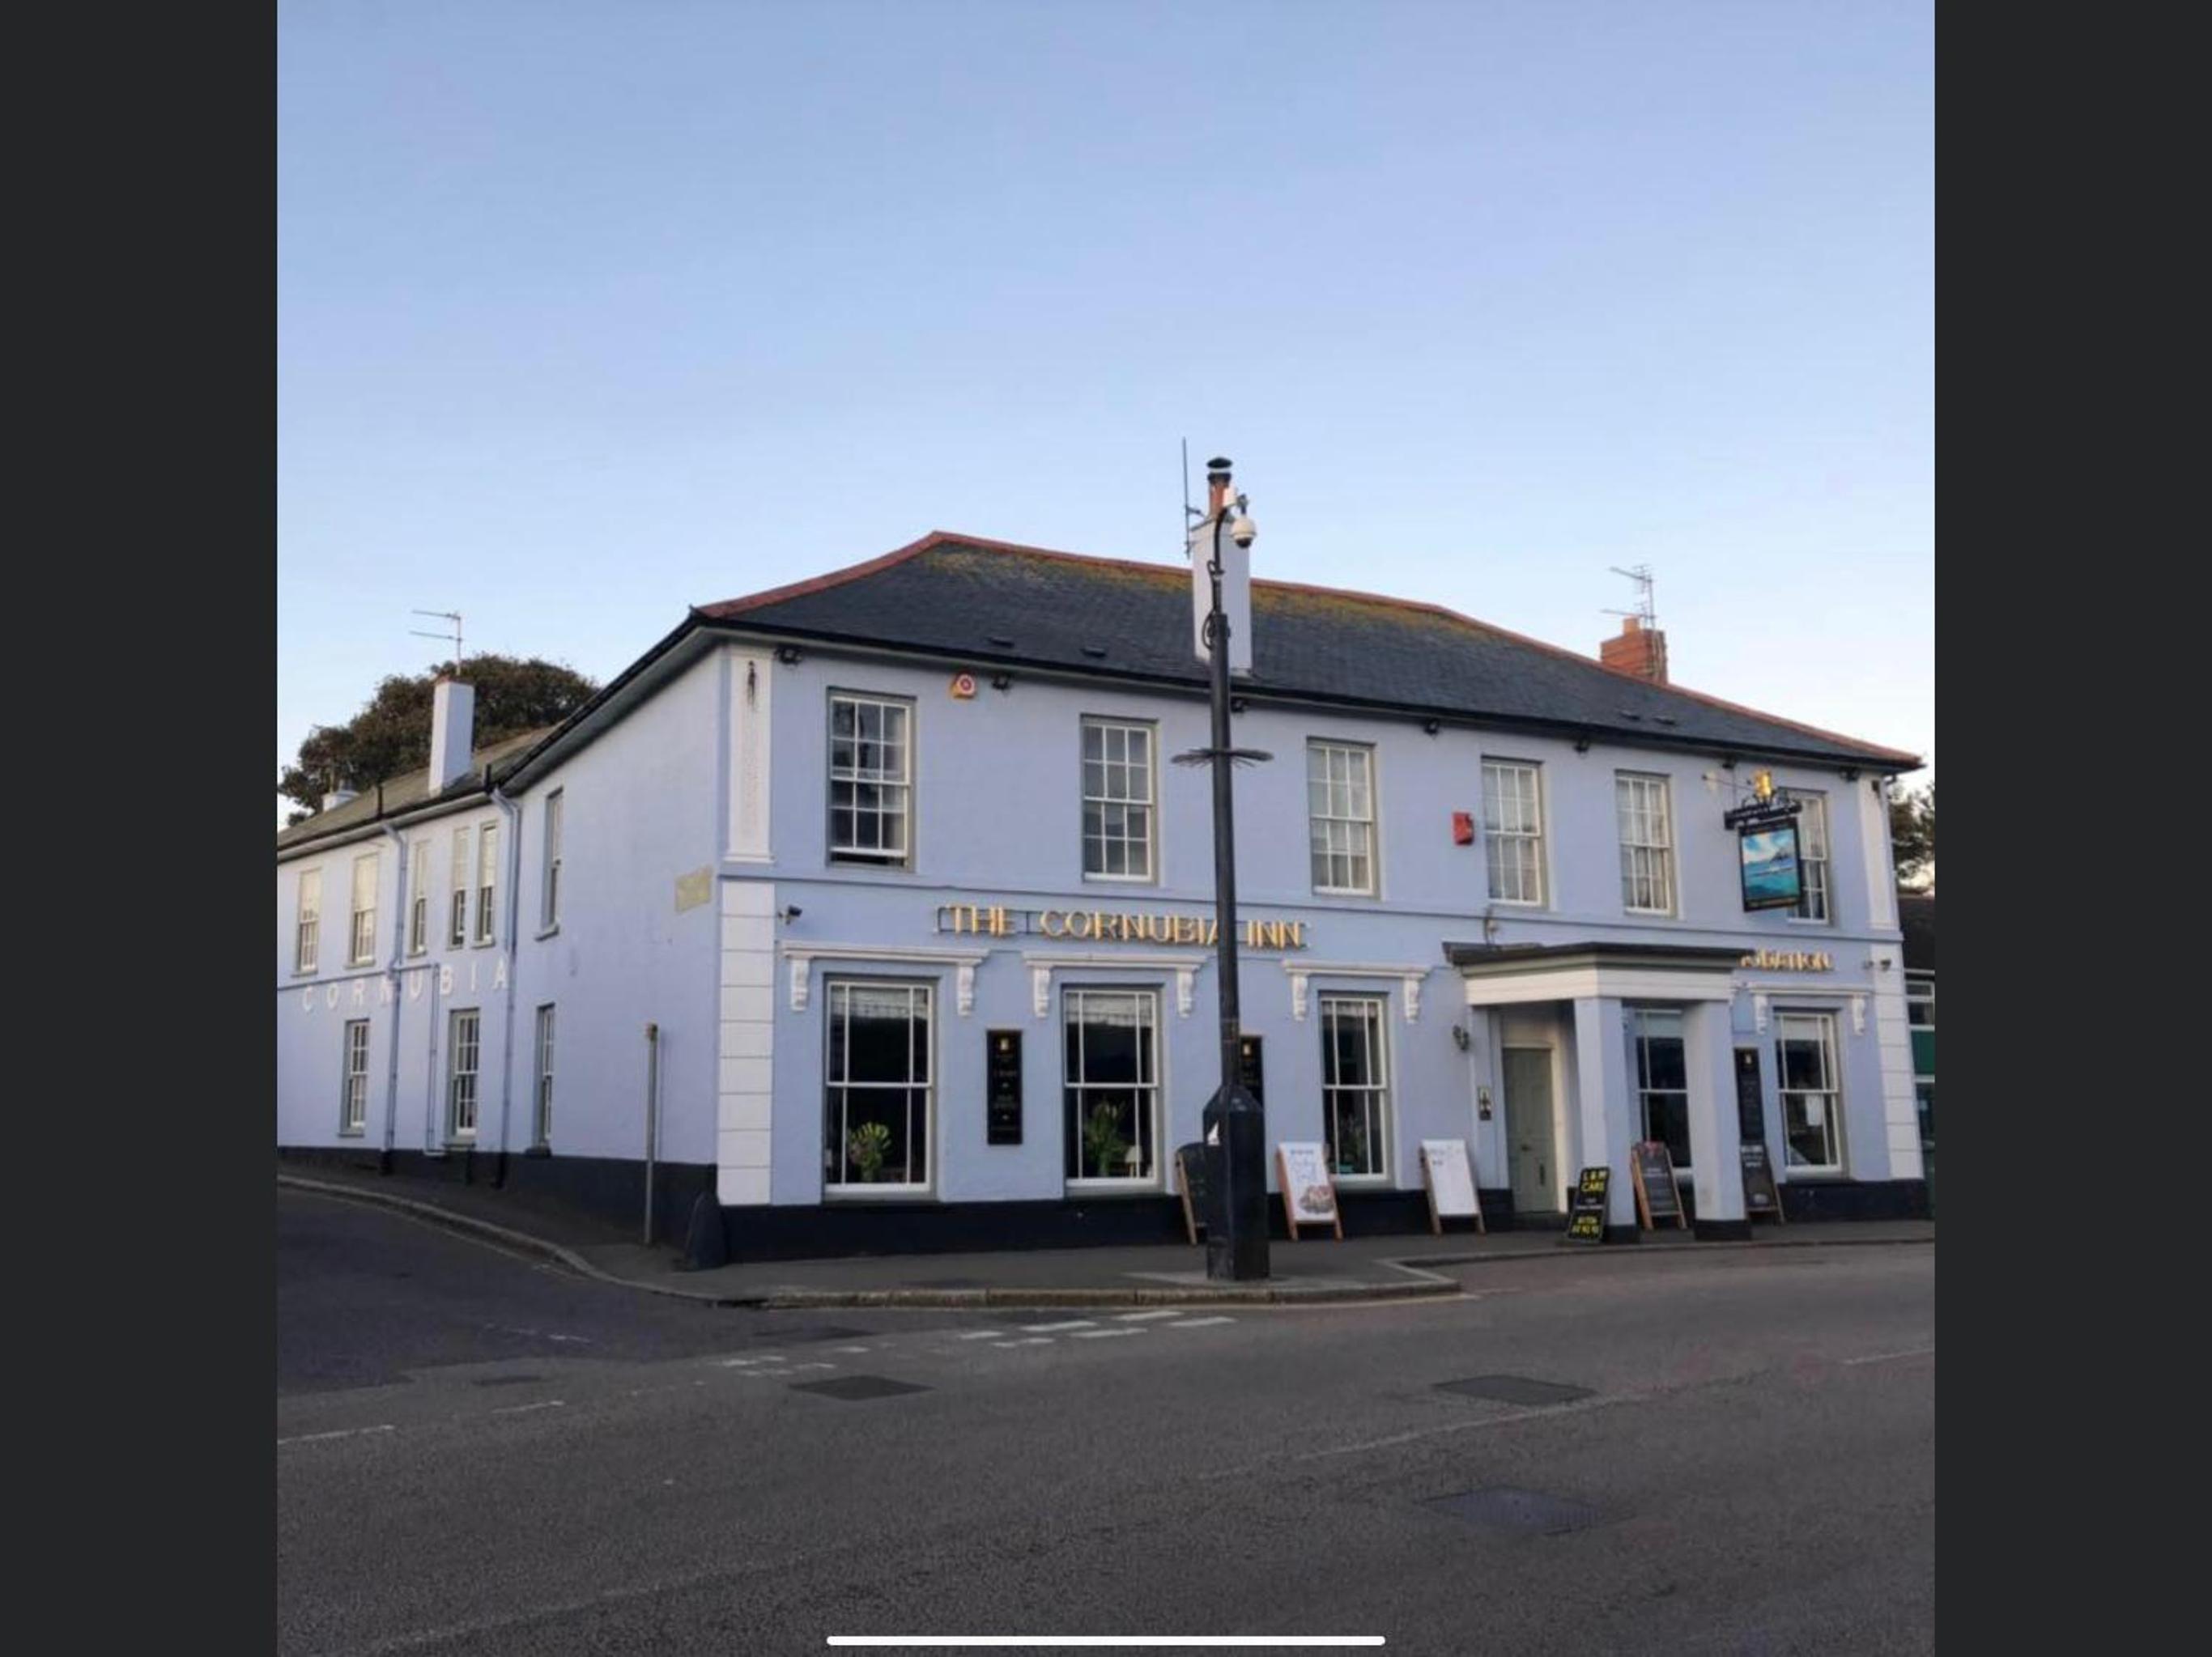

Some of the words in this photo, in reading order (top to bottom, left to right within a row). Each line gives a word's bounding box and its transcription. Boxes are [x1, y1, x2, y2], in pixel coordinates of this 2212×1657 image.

[948, 905, 1015, 936] THE
[1247, 919, 1303, 950] INN
[302, 955, 508, 1011] CORNUBIA
